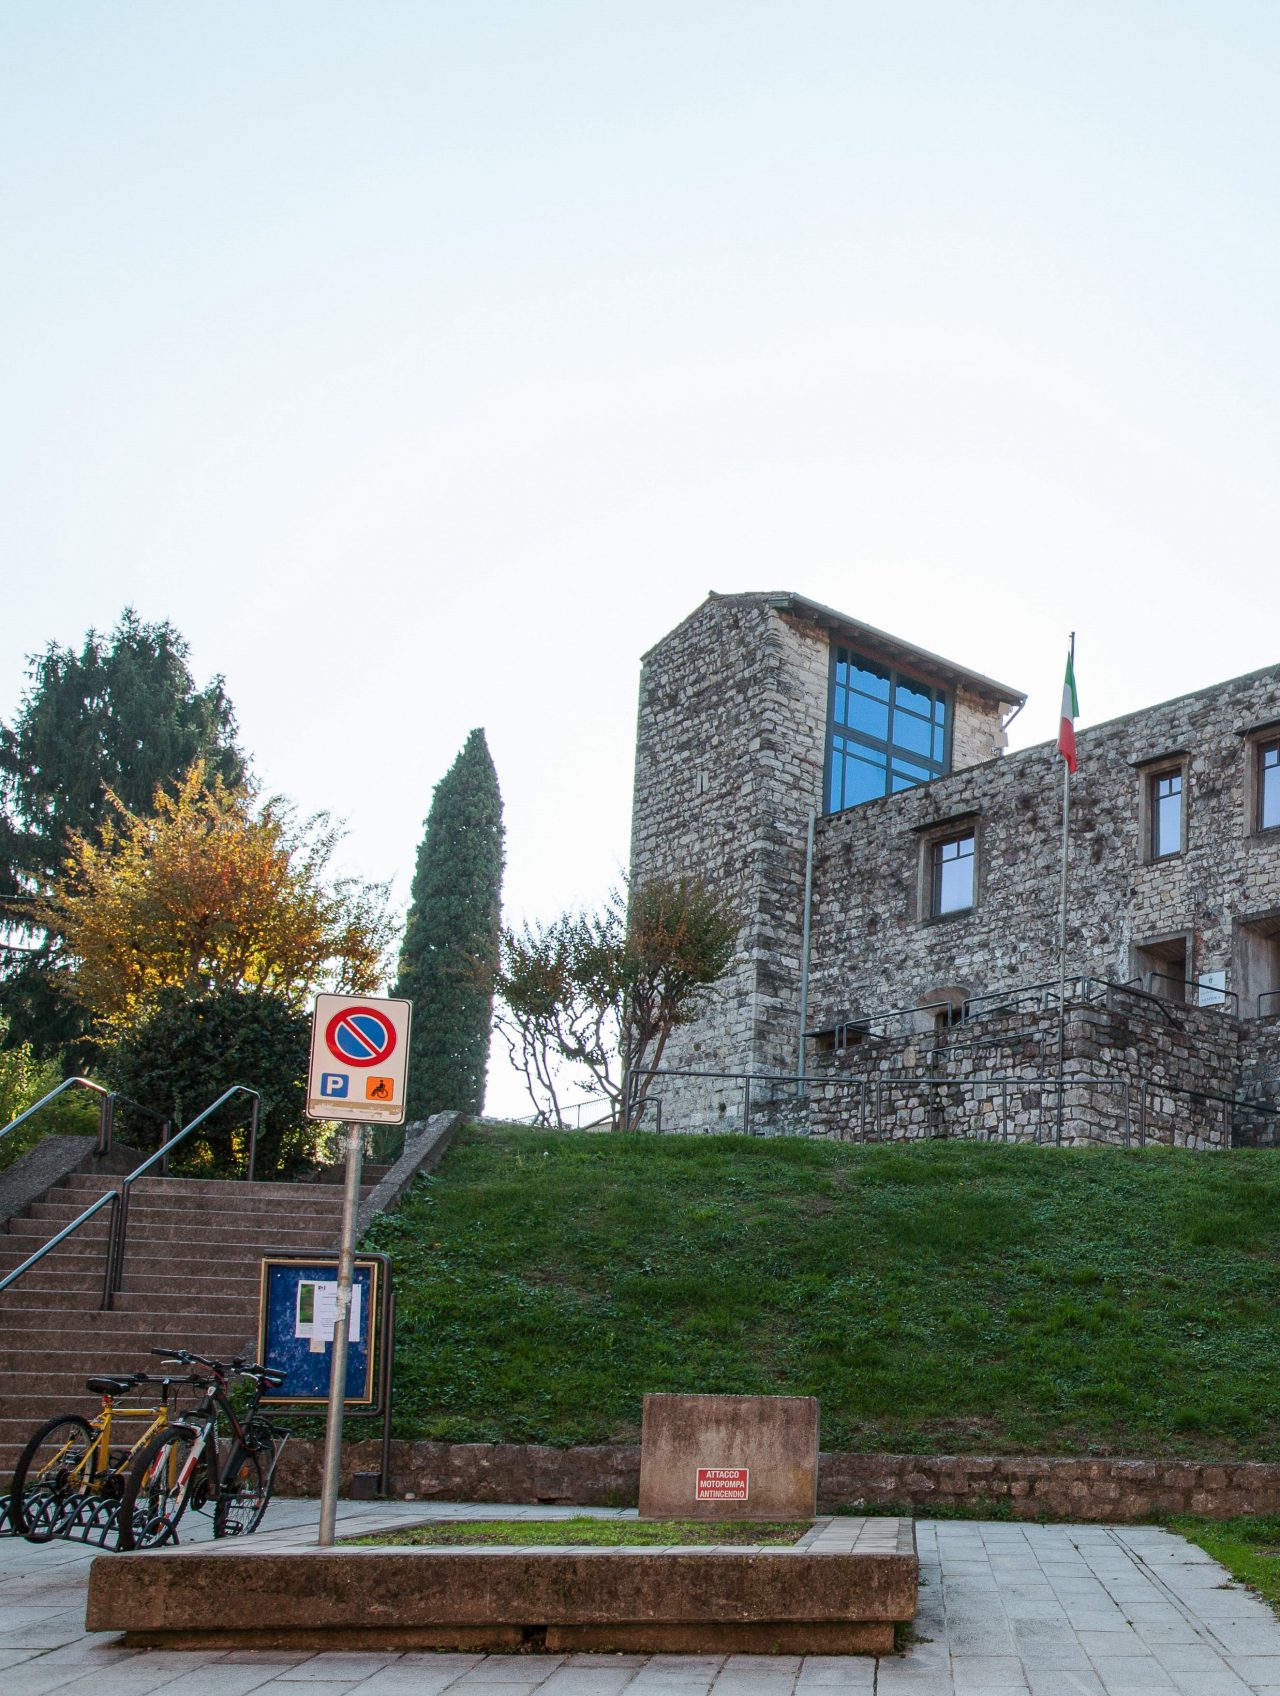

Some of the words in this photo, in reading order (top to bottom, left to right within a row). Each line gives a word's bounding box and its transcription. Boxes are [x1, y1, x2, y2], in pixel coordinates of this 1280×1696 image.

[326, 1075, 344, 1095] P
[706, 1470, 740, 1479] ATTACCO
[699, 1480, 745, 1488] MOTOPOMPA
[699, 1489, 745, 1498] ANTINCENDIO
